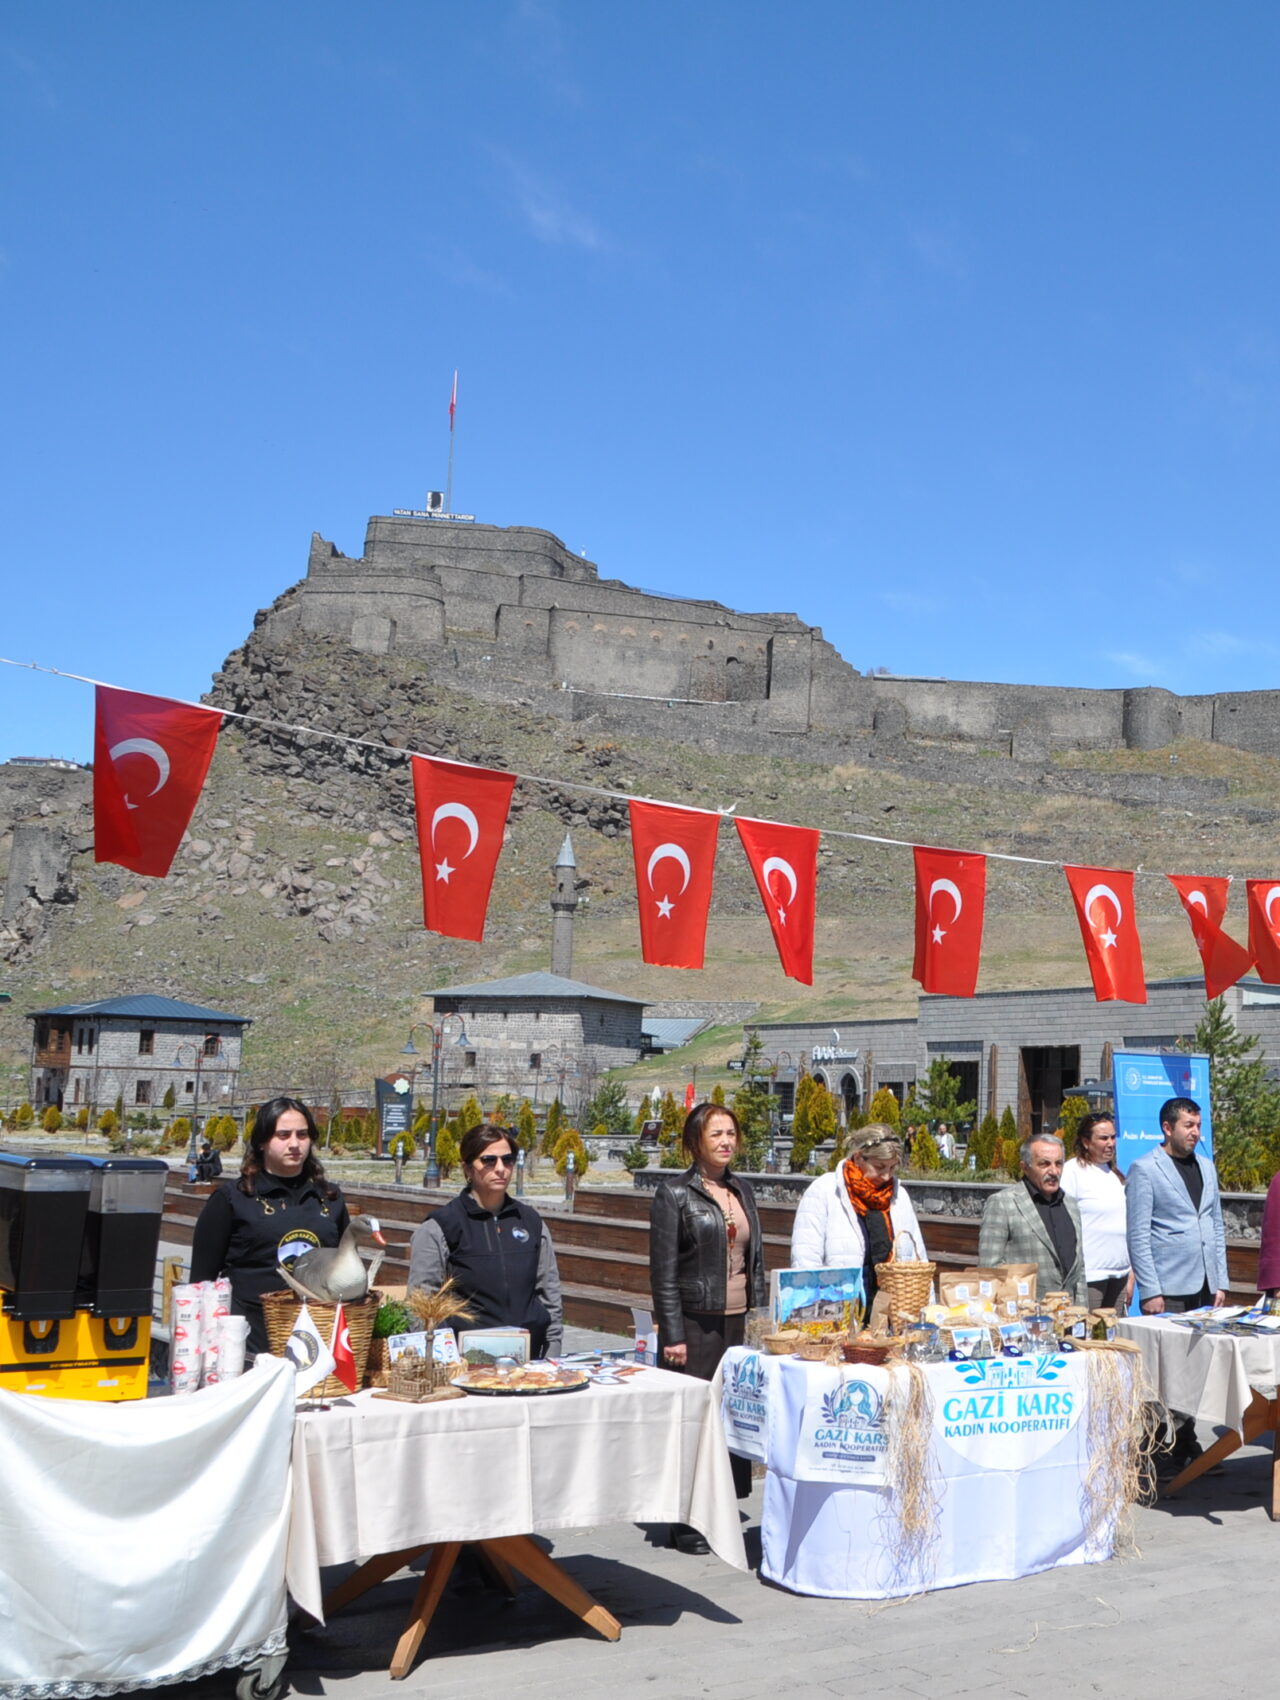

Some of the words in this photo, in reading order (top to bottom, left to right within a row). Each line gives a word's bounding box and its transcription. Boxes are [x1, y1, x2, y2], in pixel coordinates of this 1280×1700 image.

[747, 1402, 766, 1416] KARS
[943, 1391, 1005, 1422] GAZİ
[1017, 1392, 1073, 1417] KARS
[814, 1428, 849, 1442] GAZİ
[854, 1431, 890, 1445] KARS
[944, 1423, 984, 1438] KADIN
[989, 1418, 1070, 1434] KOOPERATİFİ
[814, 1441, 837, 1449] KADIN
